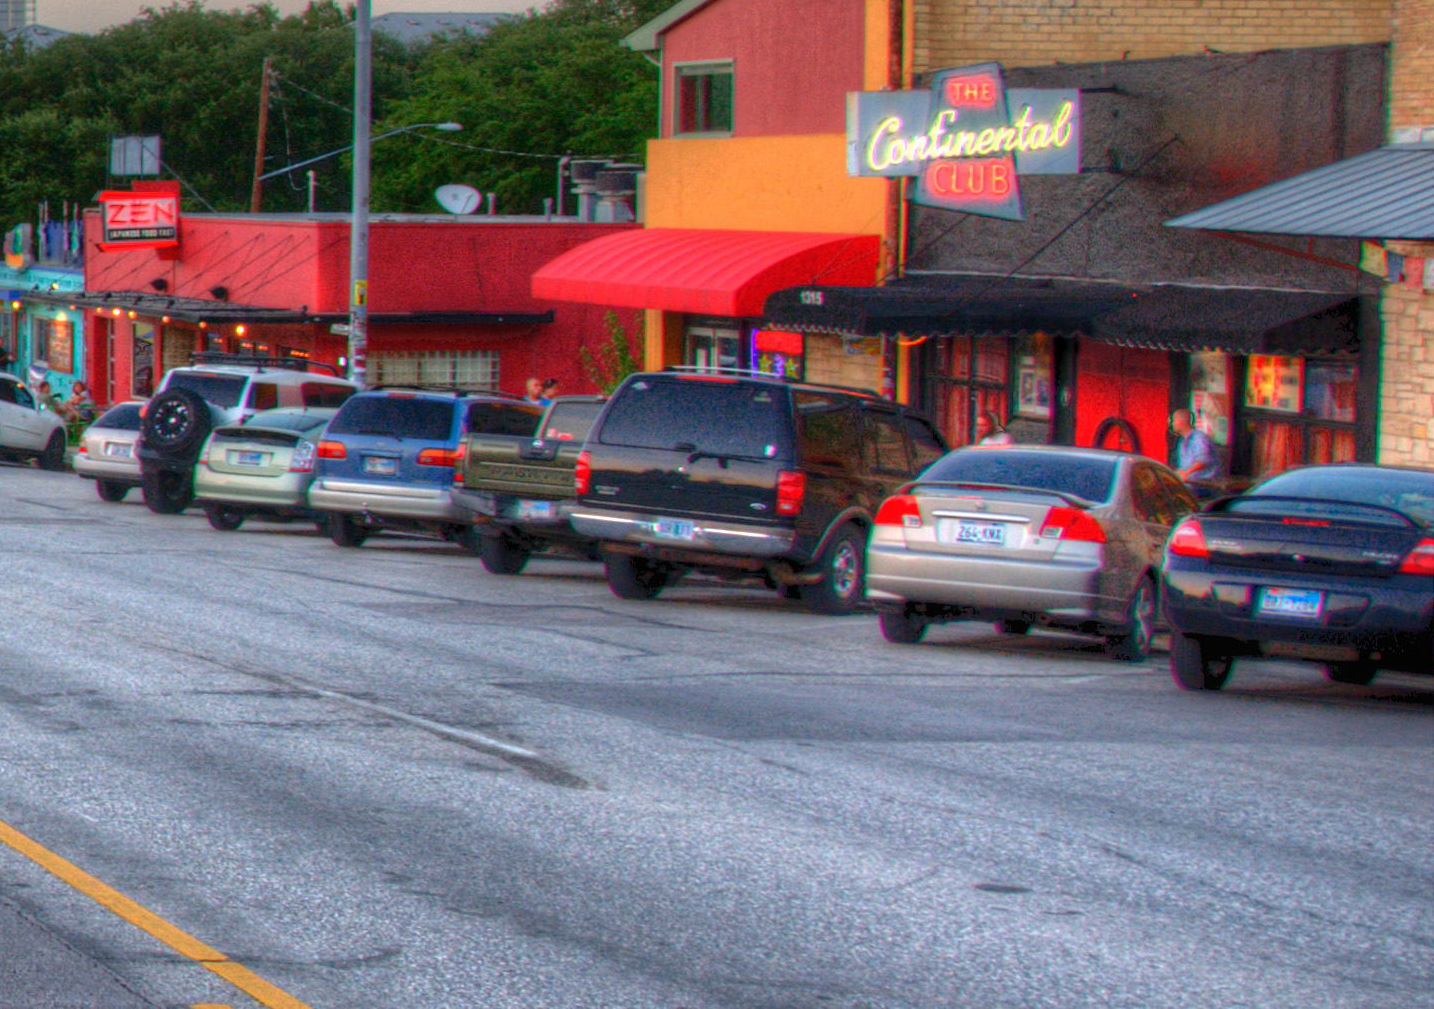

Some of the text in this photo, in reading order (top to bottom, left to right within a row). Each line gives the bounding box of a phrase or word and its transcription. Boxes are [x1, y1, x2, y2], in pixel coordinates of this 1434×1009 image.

[953, 82, 994, 102] THE
[867, 99, 1074, 170] Continental
[933, 163, 1010, 195] CLUB
[800, 290, 825, 305] 1315
